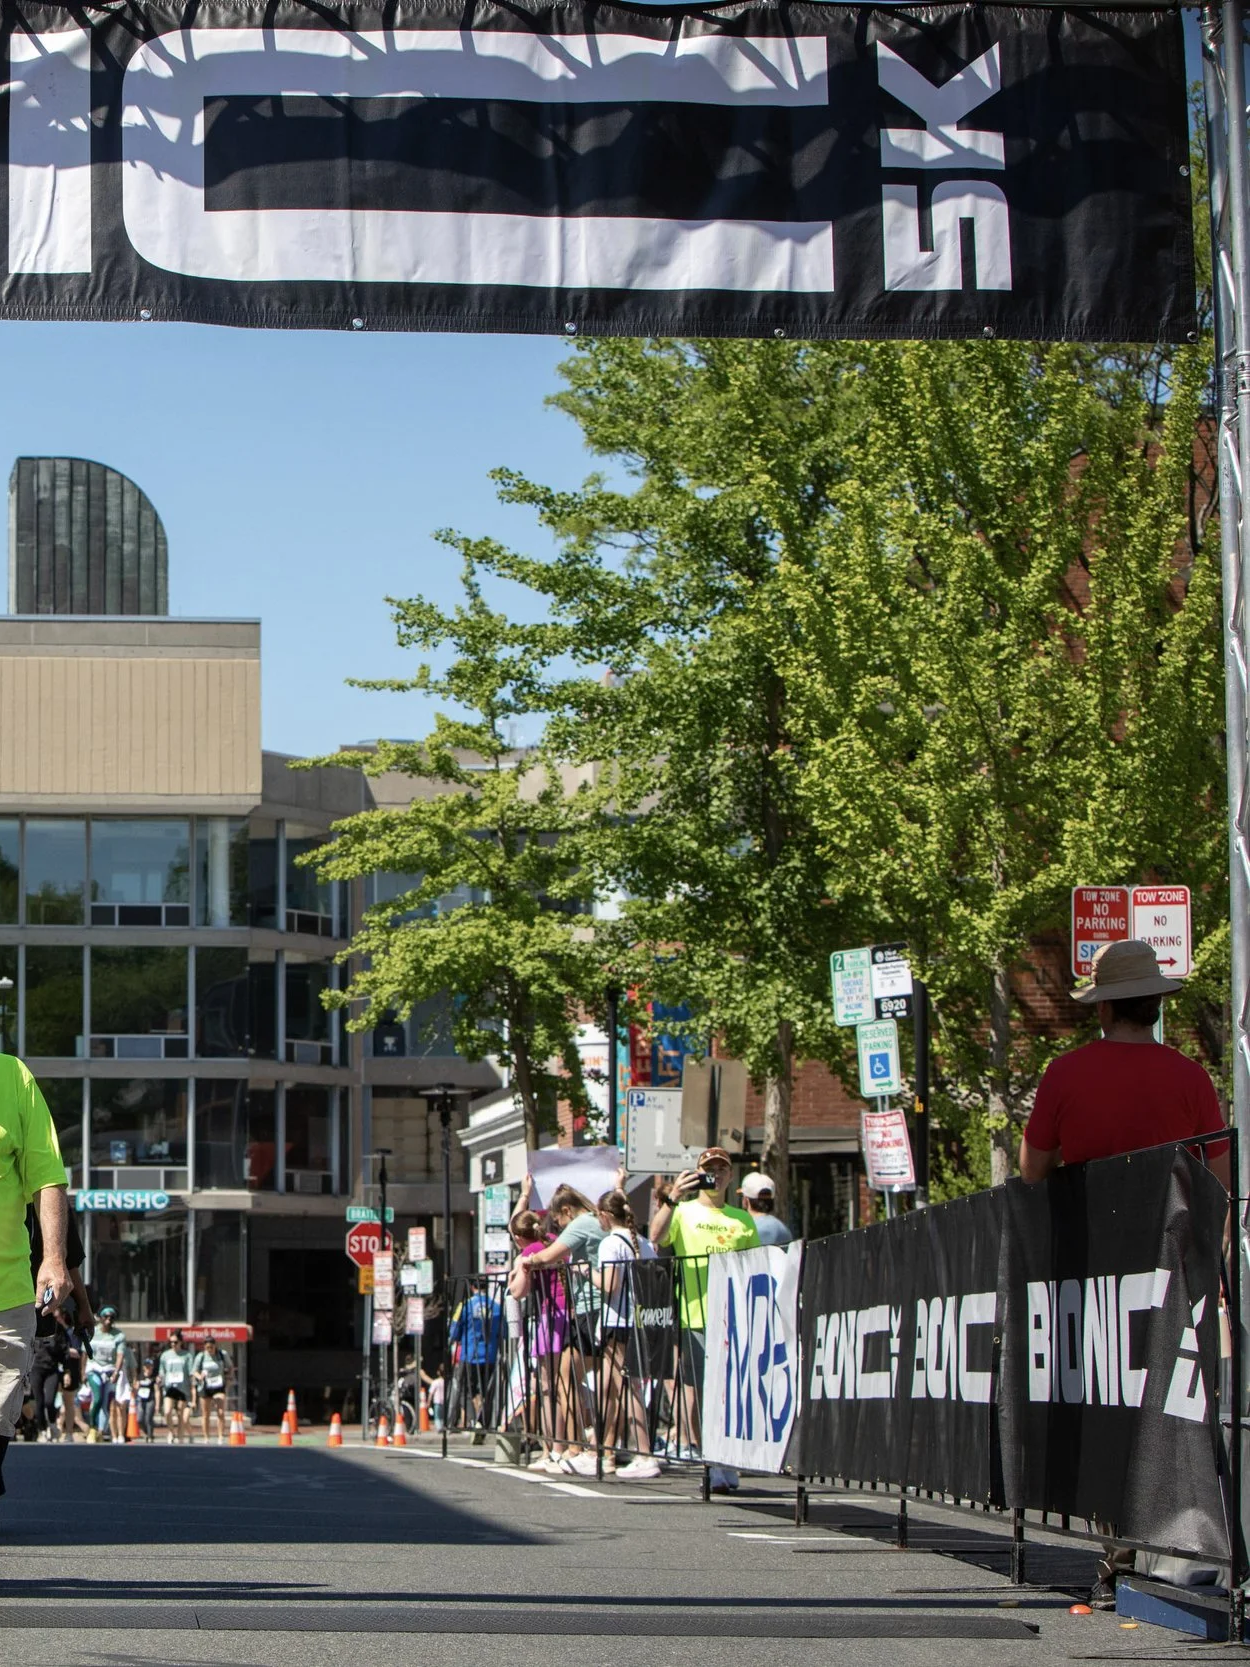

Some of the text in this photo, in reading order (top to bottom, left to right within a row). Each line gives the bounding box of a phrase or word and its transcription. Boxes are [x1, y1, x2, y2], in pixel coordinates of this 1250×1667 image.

[876, 41, 1012, 292] 5K
[1082, 891, 1121, 902] TOW ZONE
[1136, 891, 1185, 902] TOW ZONE
[1093, 903, 1109, 916] NO
[1076, 916, 1126, 930] PARKING
[1154, 915, 1168, 926] NO
[1140, 935, 1182, 947] PARKING
[834, 954, 843, 971] 2
[881, 998, 907, 1012] 6920
[861, 1027, 894, 1039] RESERVED
[863, 1039, 893, 1049] PARKING
[79, 1191, 169, 1210] KENSHO
